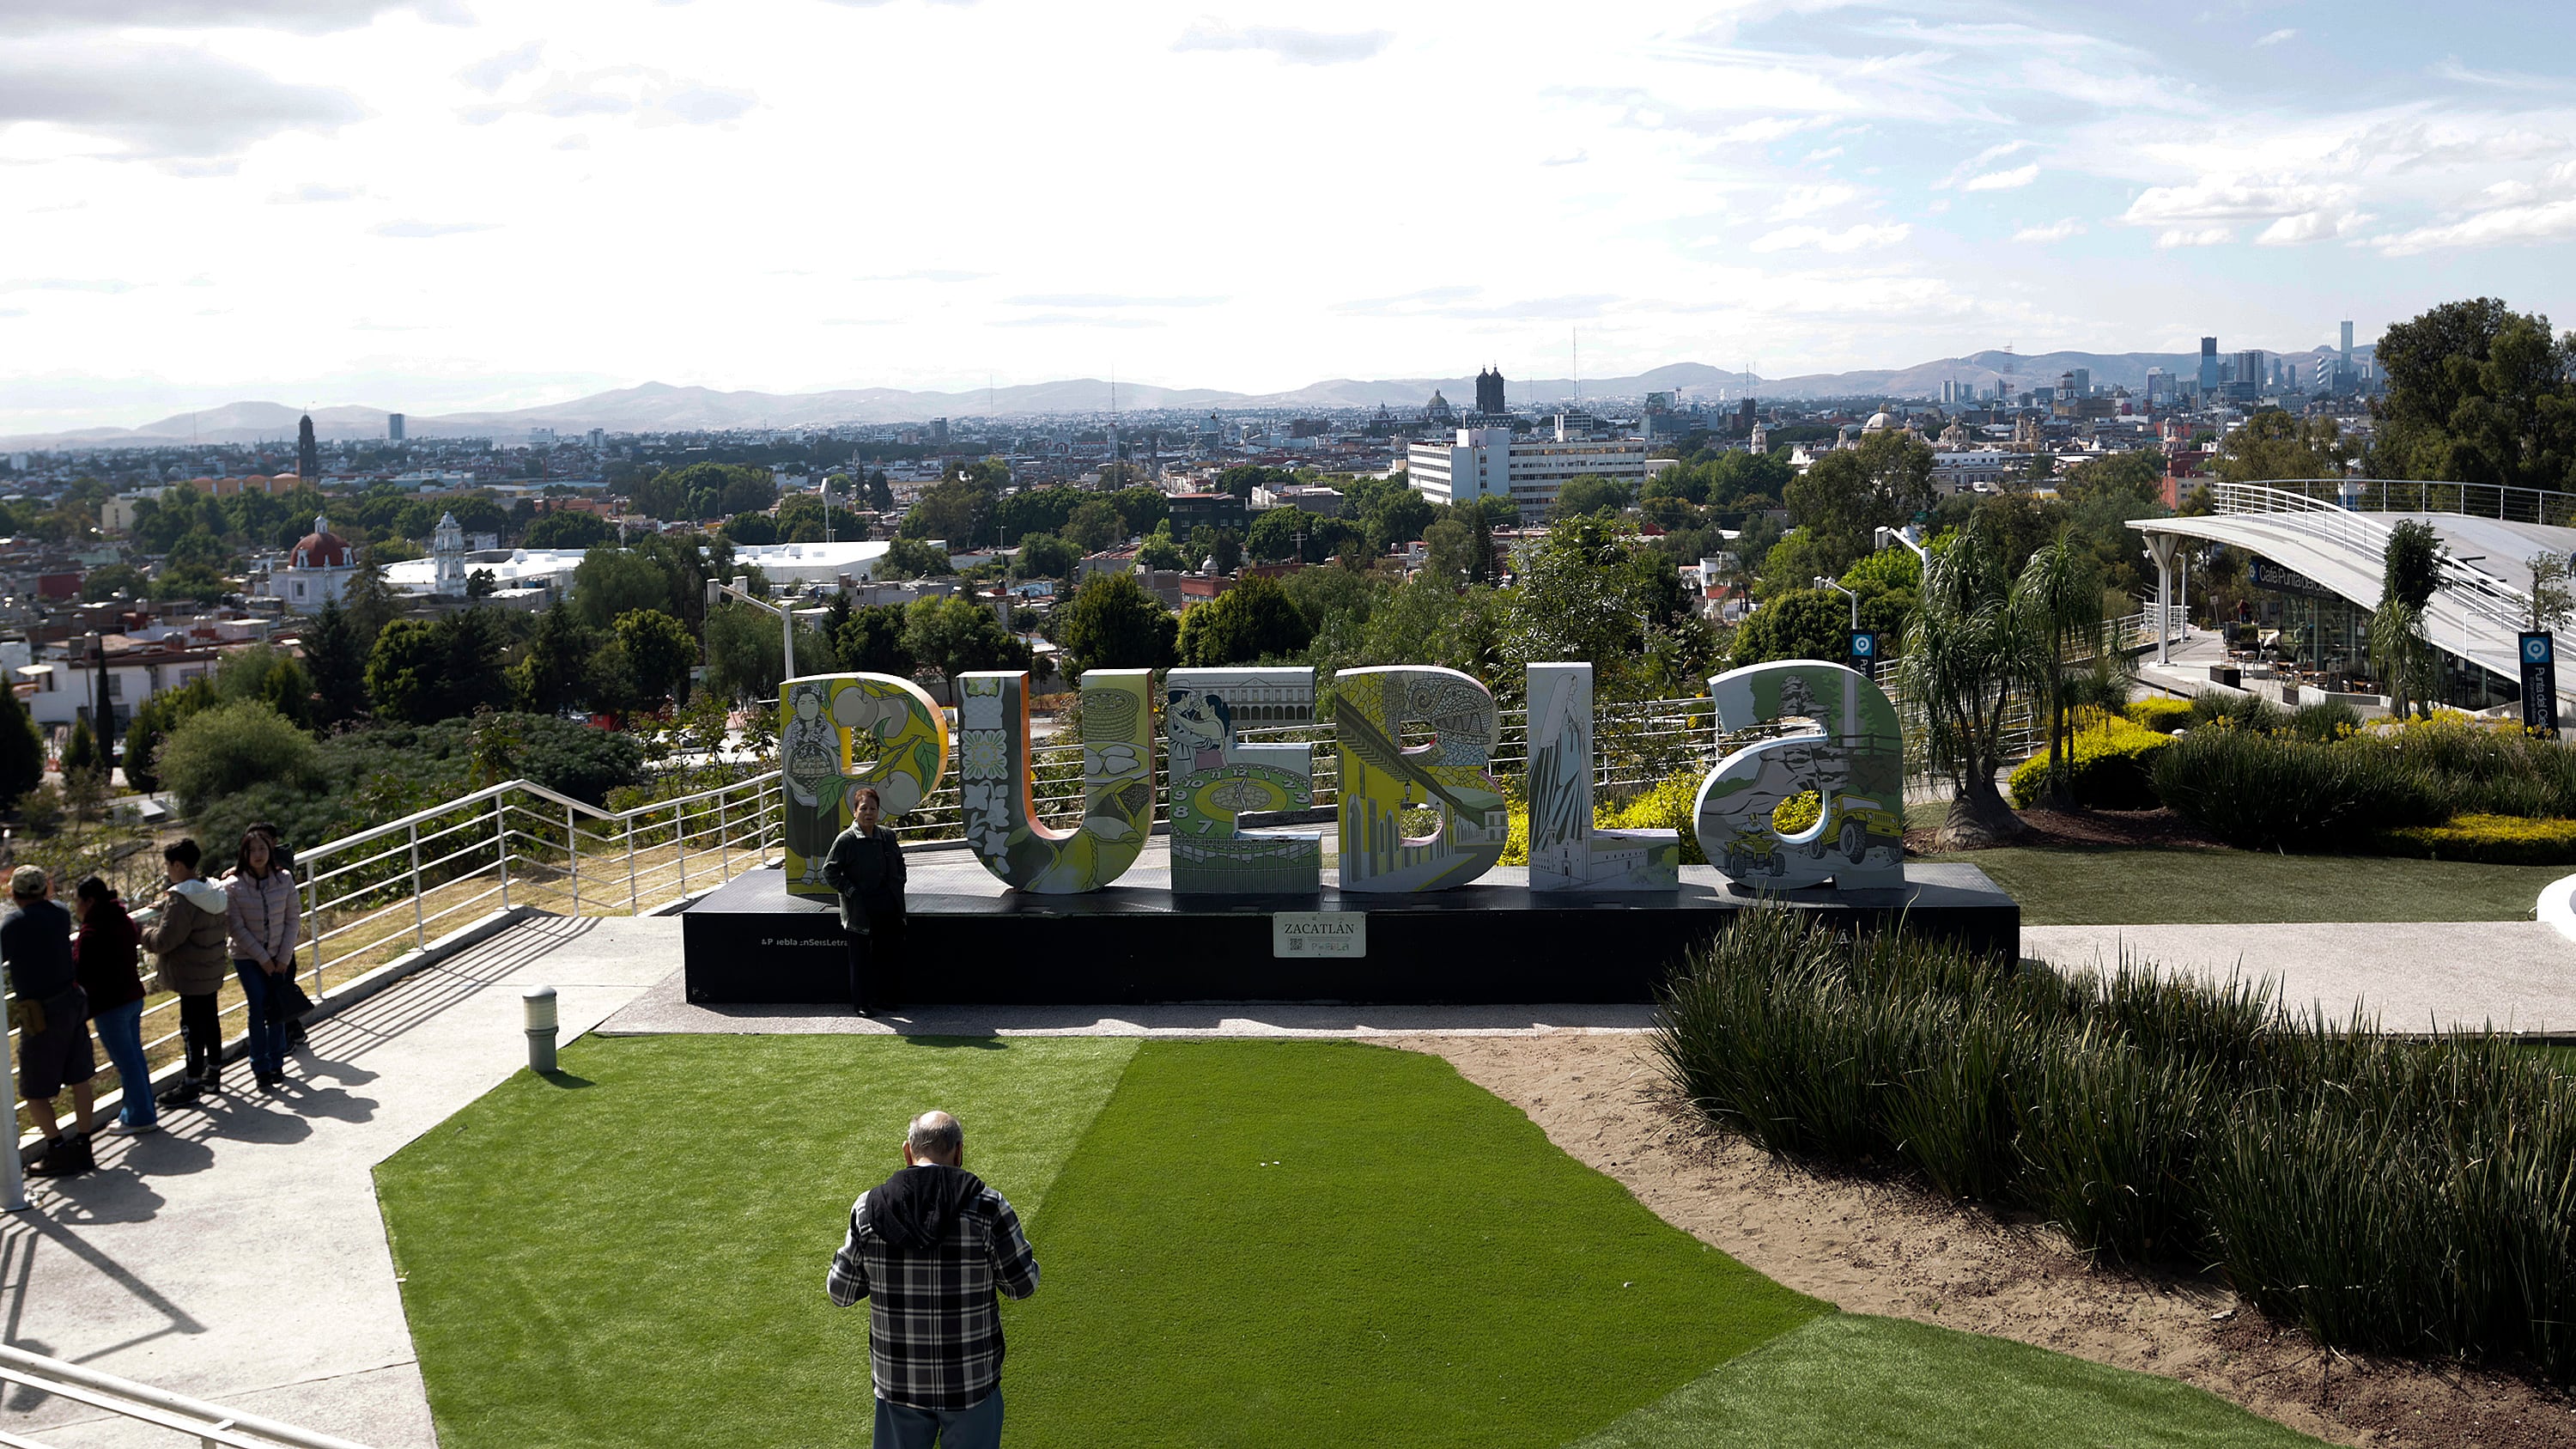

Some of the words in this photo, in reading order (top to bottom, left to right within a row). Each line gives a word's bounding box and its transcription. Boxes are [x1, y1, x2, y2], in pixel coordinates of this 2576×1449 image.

[2259, 564, 2278, 583] Café
[2278, 568, 2301, 588] Punta
[1860, 659, 1868, 675] Pun
[2535, 667, 2545, 693] Punta
[2537, 693, 2548, 708] del
[2537, 709, 2549, 731] Cielo
[1284, 780, 1297, 788] 2
[1174, 790, 1188, 801] 9
[1294, 792, 1309, 803] 3
[1173, 806, 1188, 818] 8
[1197, 820, 1214, 834] 7
[1285, 922, 1354, 934] ZACATLÁN
